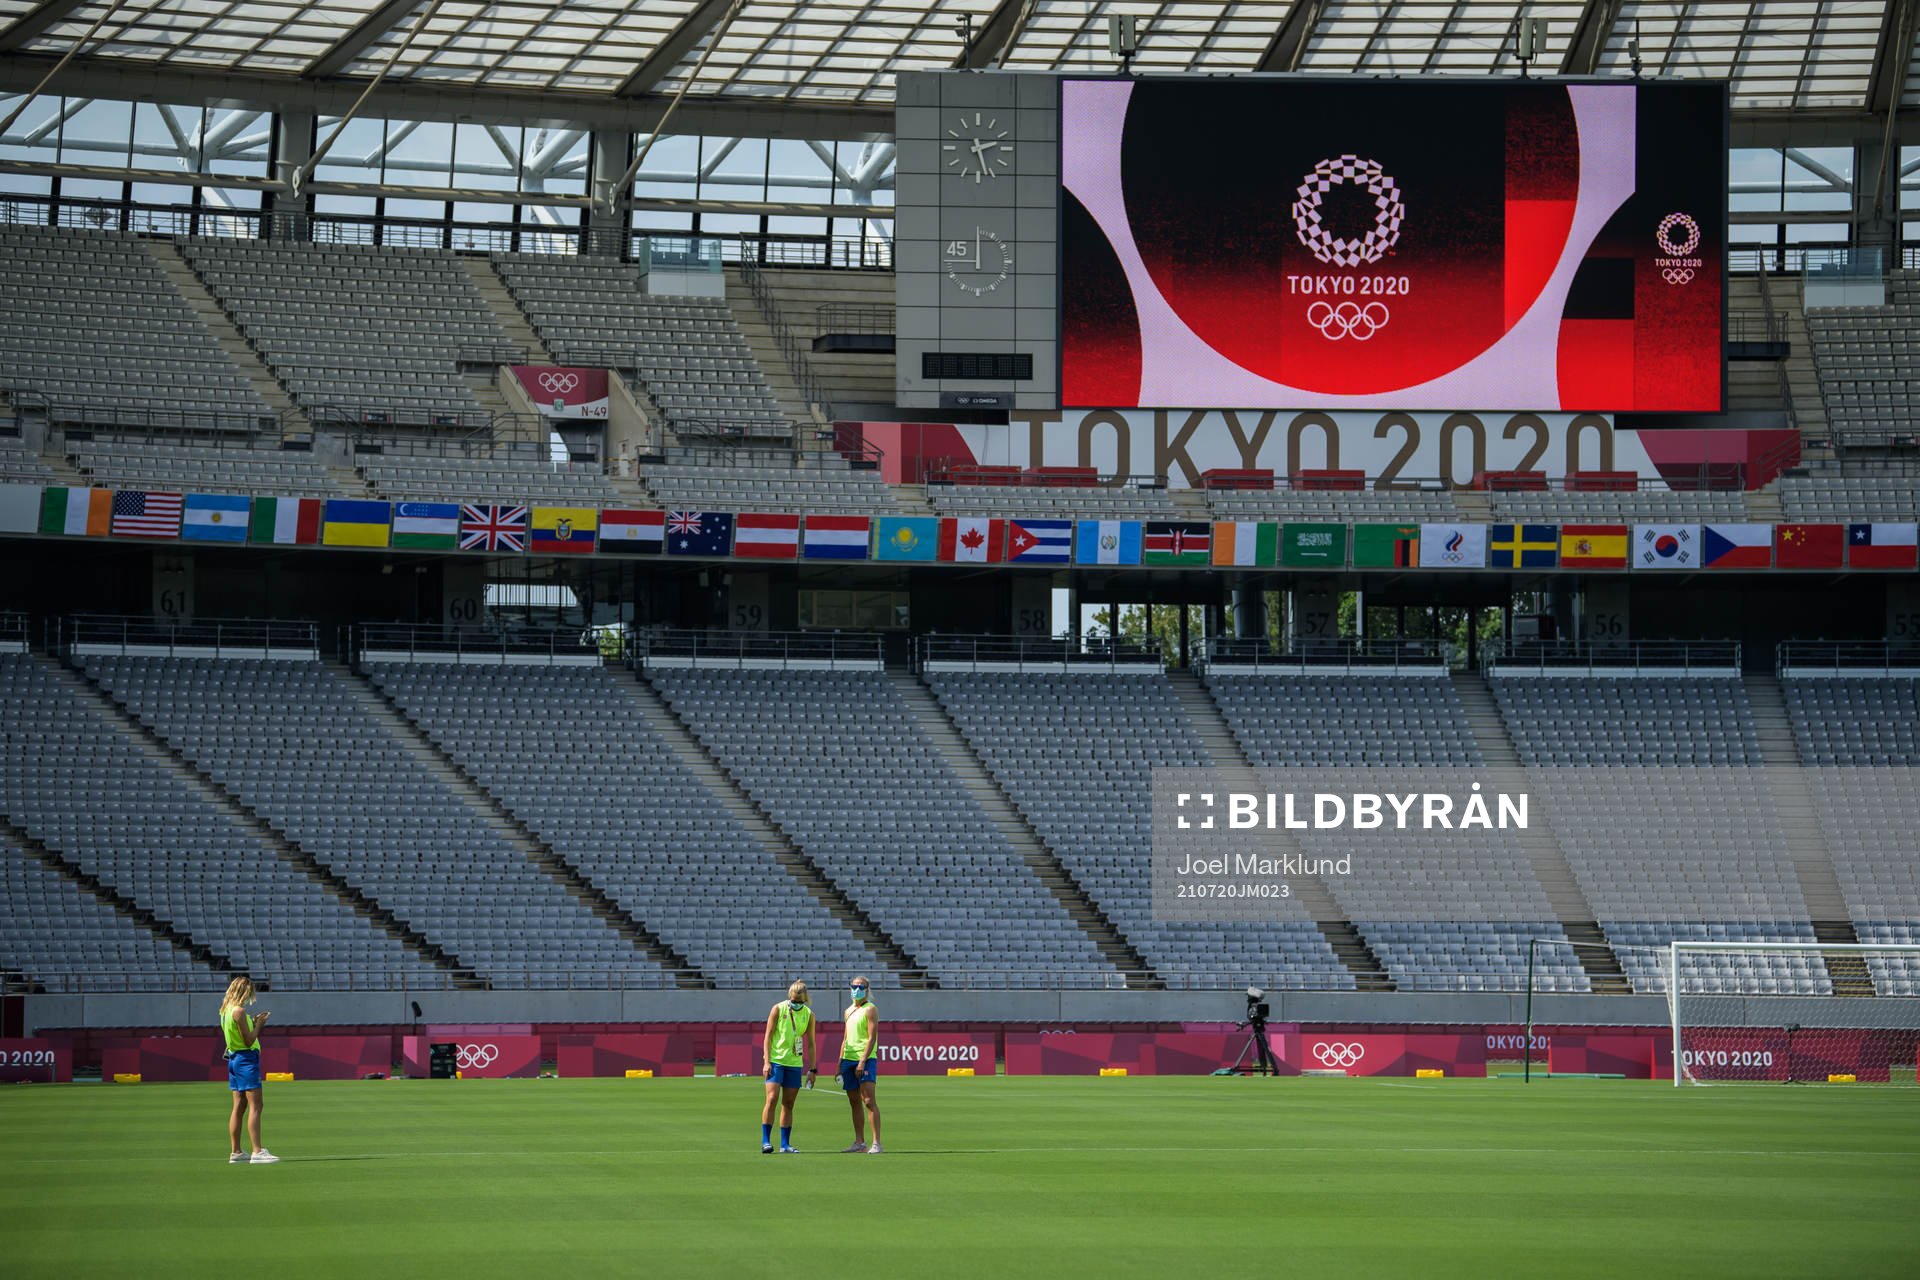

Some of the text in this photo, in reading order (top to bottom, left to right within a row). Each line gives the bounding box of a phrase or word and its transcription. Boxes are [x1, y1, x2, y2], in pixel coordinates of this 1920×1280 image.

[946, 241, 967, 256] 45
[1287, 276, 1410, 294] TOKYO 2020
[581, 406, 607, 416] N-49
[1010, 409, 1613, 491] TOKYO 2020
[161, 590, 186, 614] 61
[451, 598, 478, 621] 60
[736, 605, 762, 627] 59
[1020, 609, 1046, 632] 58
[1305, 612, 1331, 635] 57
[1595, 614, 1623, 637] 56
[1486, 1035, 1526, 1049] OKYO
[11, 1050, 55, 1066] 2020
[879, 1046, 979, 1061] TOKYO 2020
[1671, 1050, 1773, 1066] OKYO 2020
